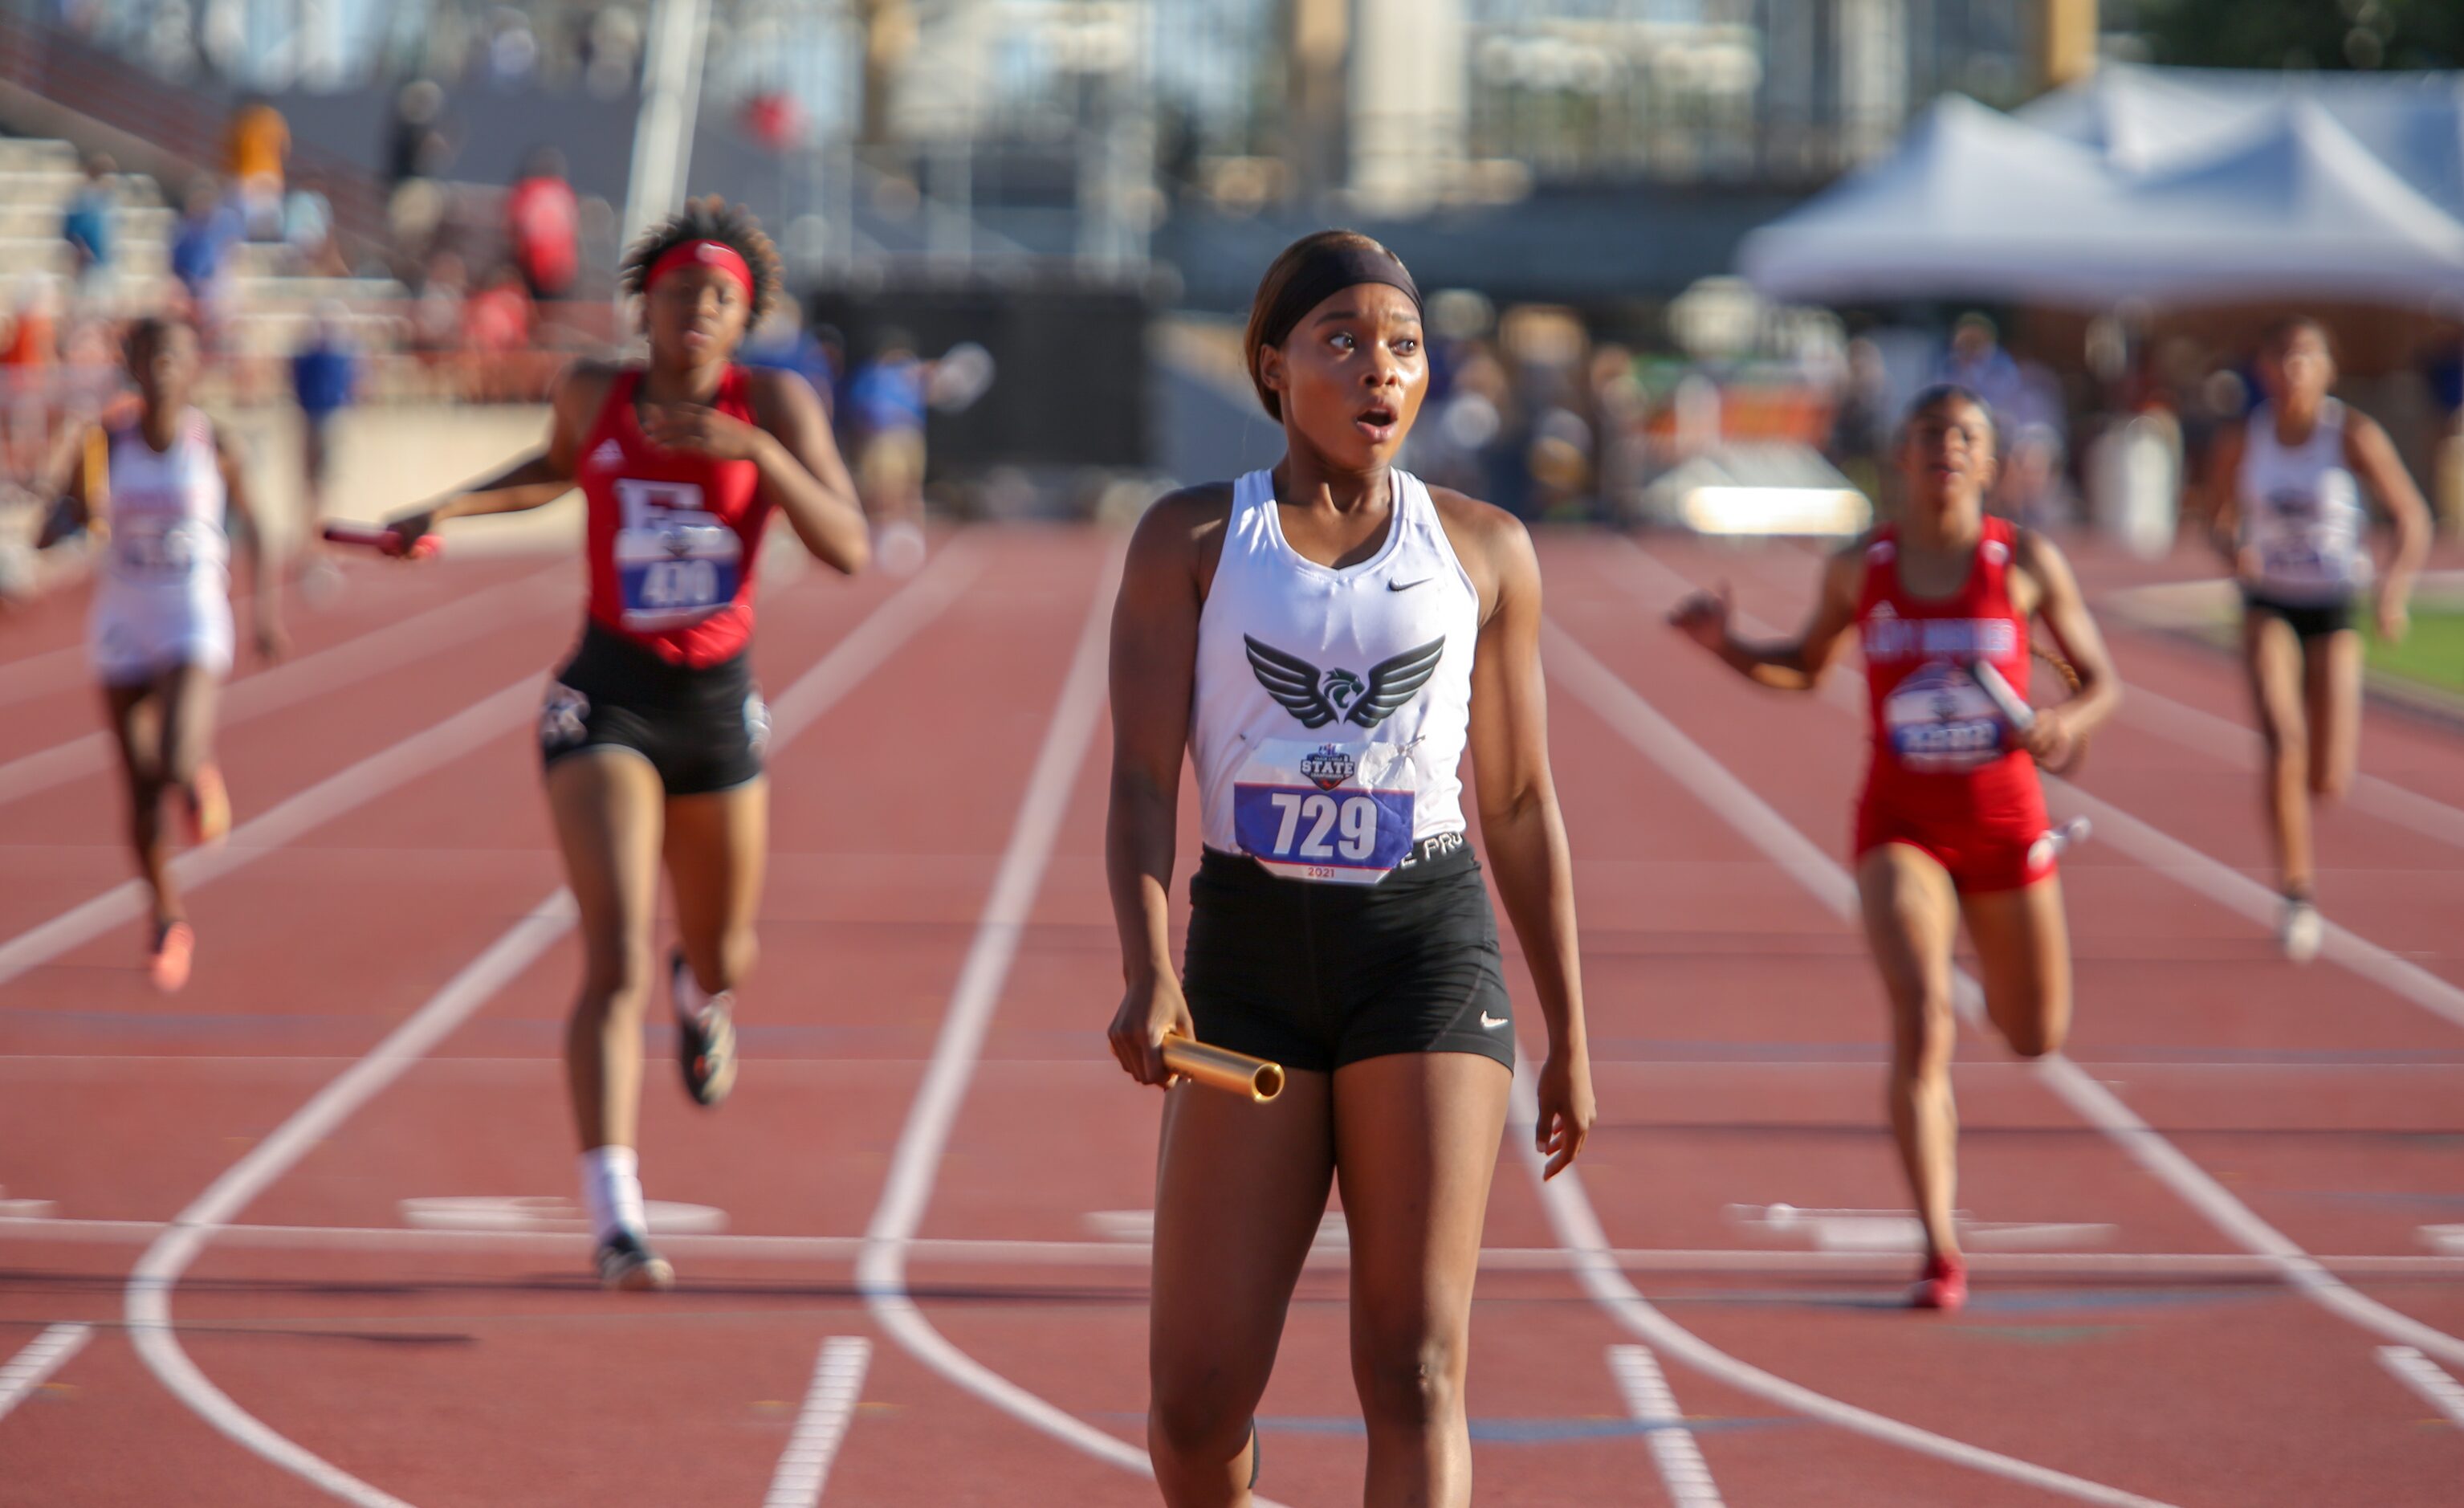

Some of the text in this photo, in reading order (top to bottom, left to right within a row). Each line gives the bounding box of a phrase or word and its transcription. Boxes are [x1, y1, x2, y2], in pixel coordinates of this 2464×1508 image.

[1301, 760, 1354, 775] STATE
[1271, 793, 1378, 860] 729
[1308, 866, 1335, 878] 2021
